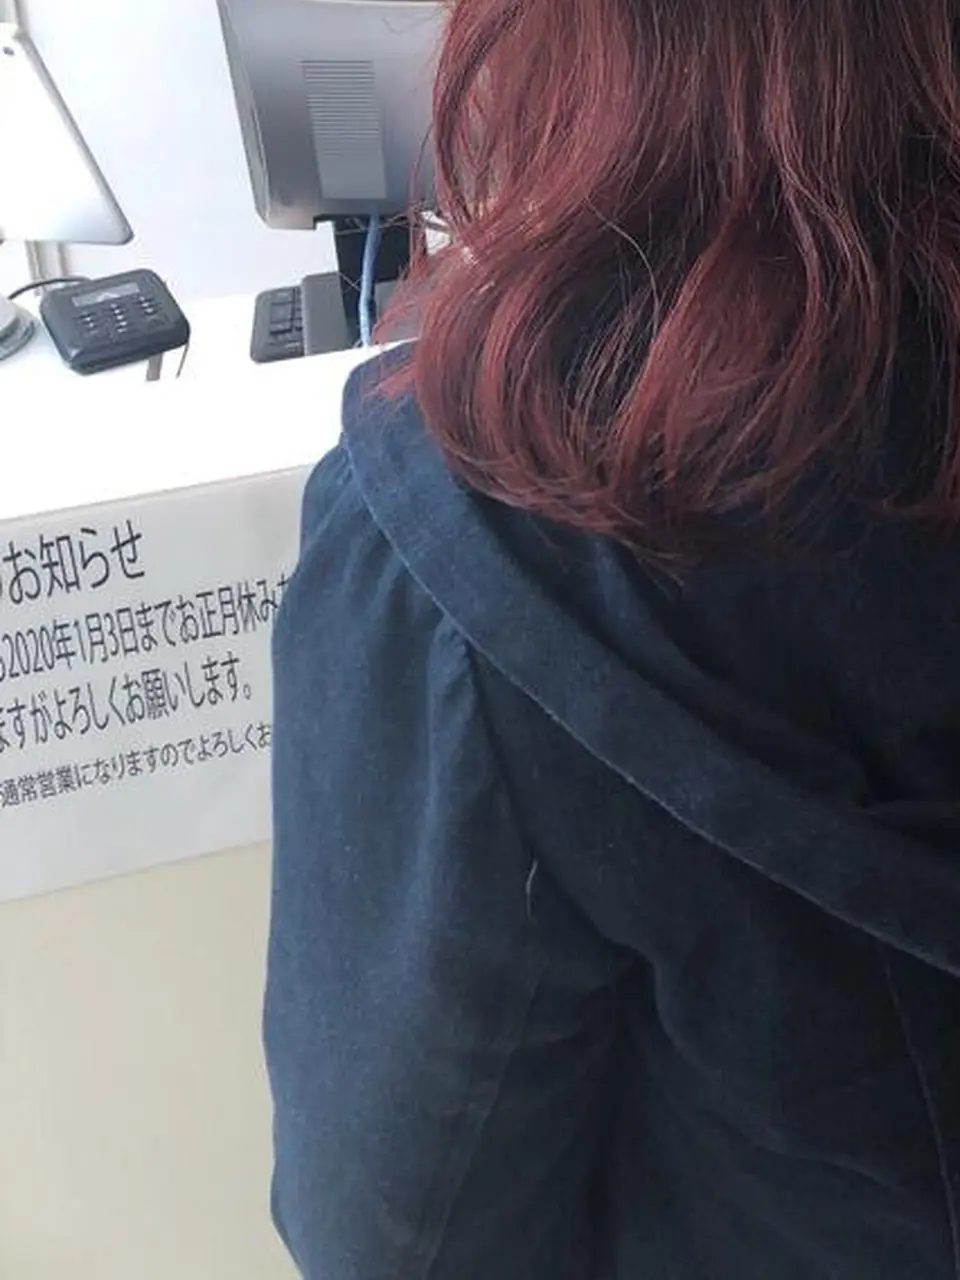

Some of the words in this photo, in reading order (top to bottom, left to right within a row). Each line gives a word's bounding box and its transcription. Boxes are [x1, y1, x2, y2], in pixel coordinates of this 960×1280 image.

[0, 519, 145, 604] お知らせ
[0, 572, 289, 683] 2020年1月3日までお正月休み
[0, 721, 271, 807] 通常営業になりますのでよろしくお
